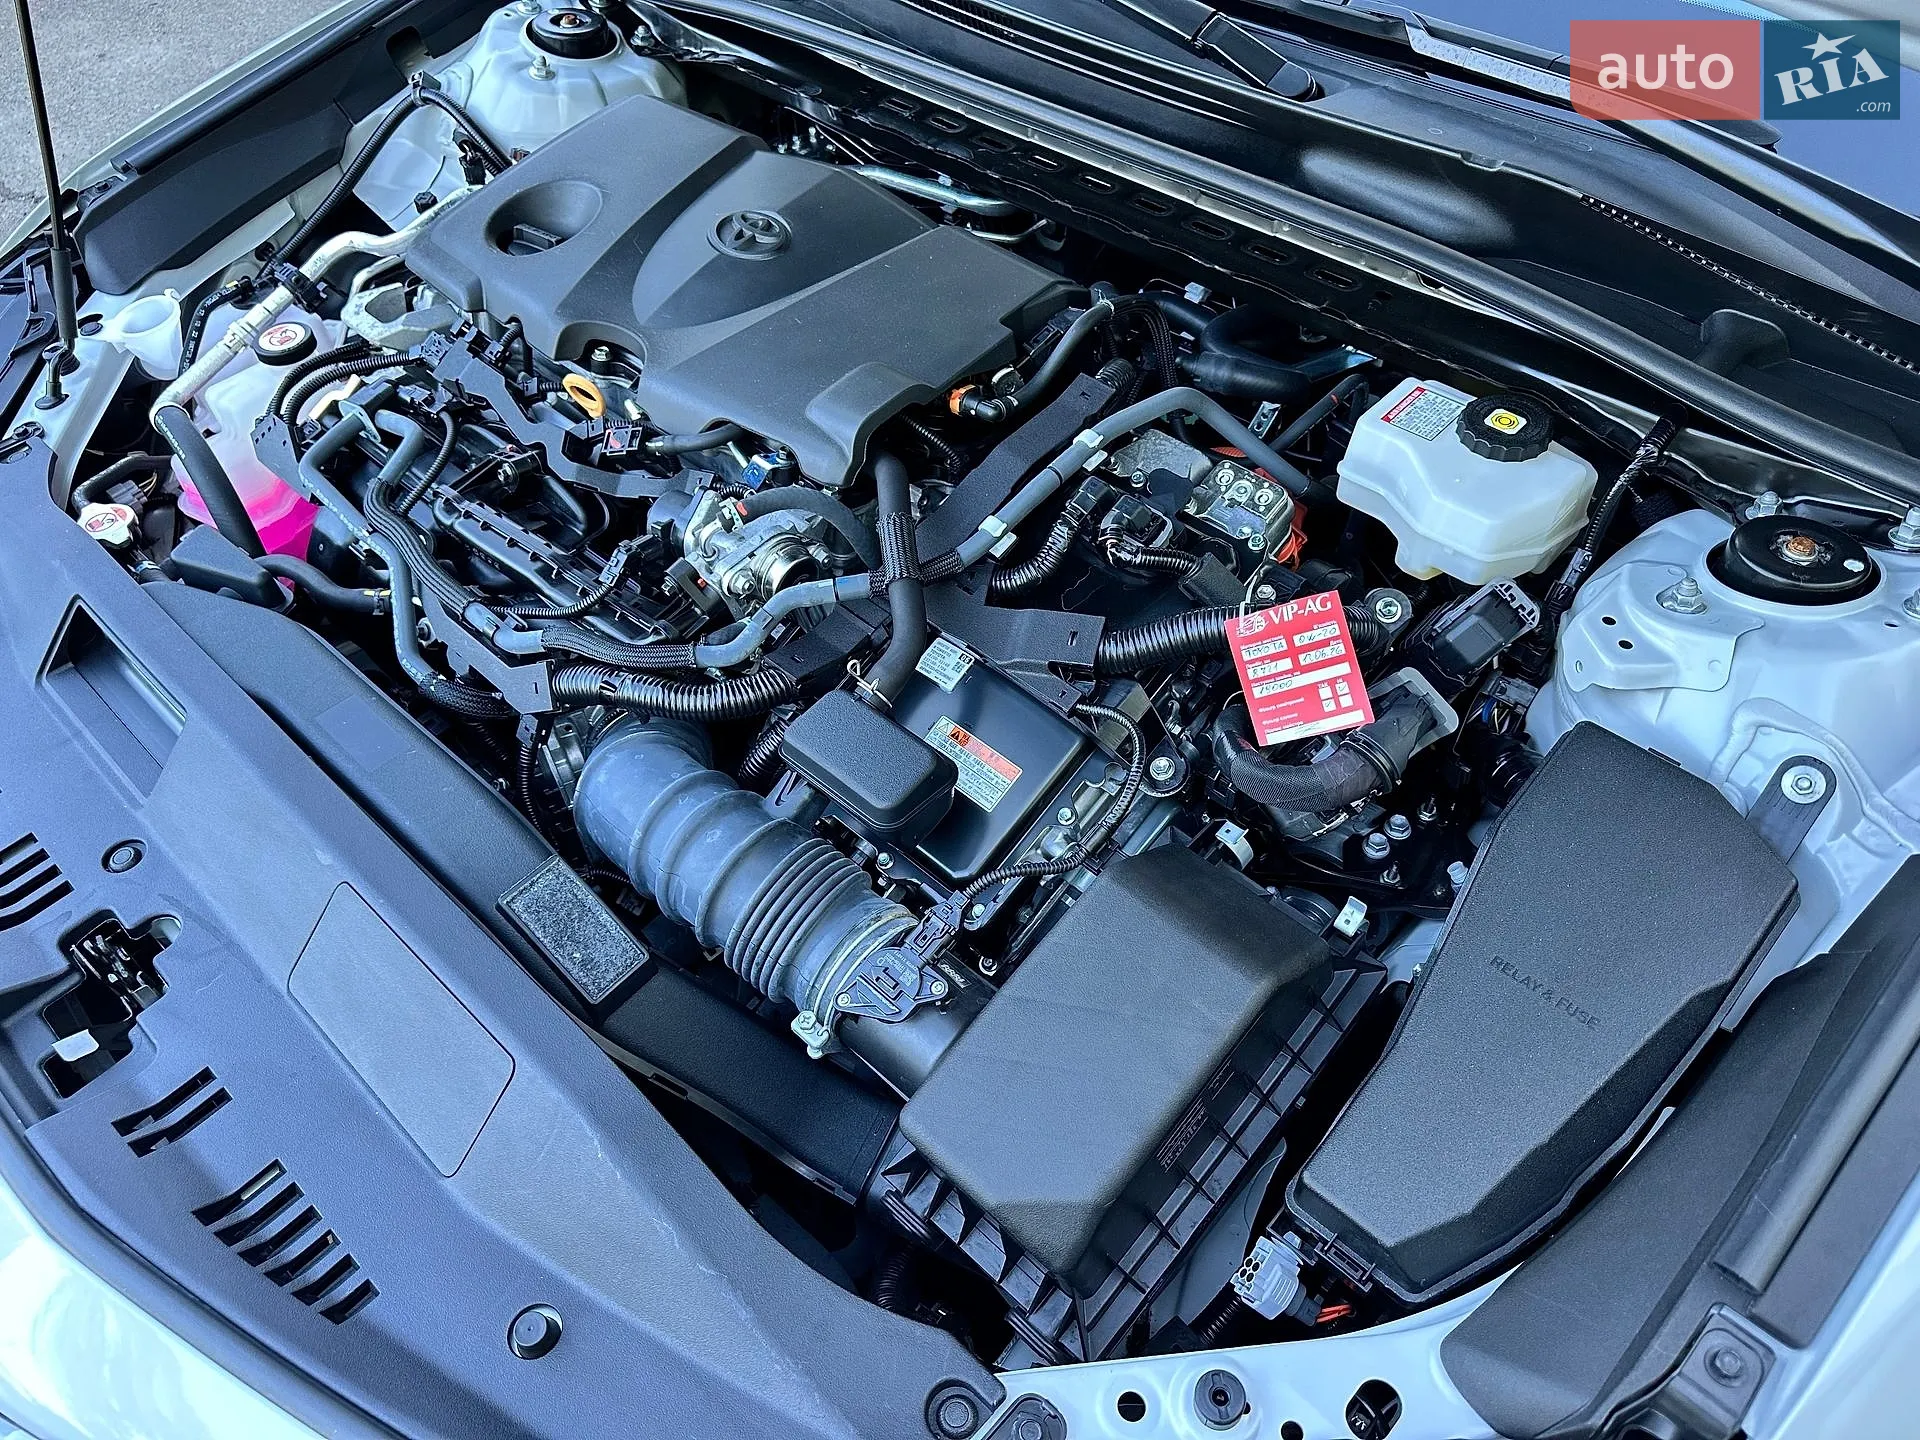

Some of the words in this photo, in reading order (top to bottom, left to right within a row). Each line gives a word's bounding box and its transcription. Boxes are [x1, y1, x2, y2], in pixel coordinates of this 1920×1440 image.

[1268, 593, 1332, 625] VIP-AG
[1490, 955, 1544, 992] RELAY
[1555, 996, 1601, 1031] FUSE
